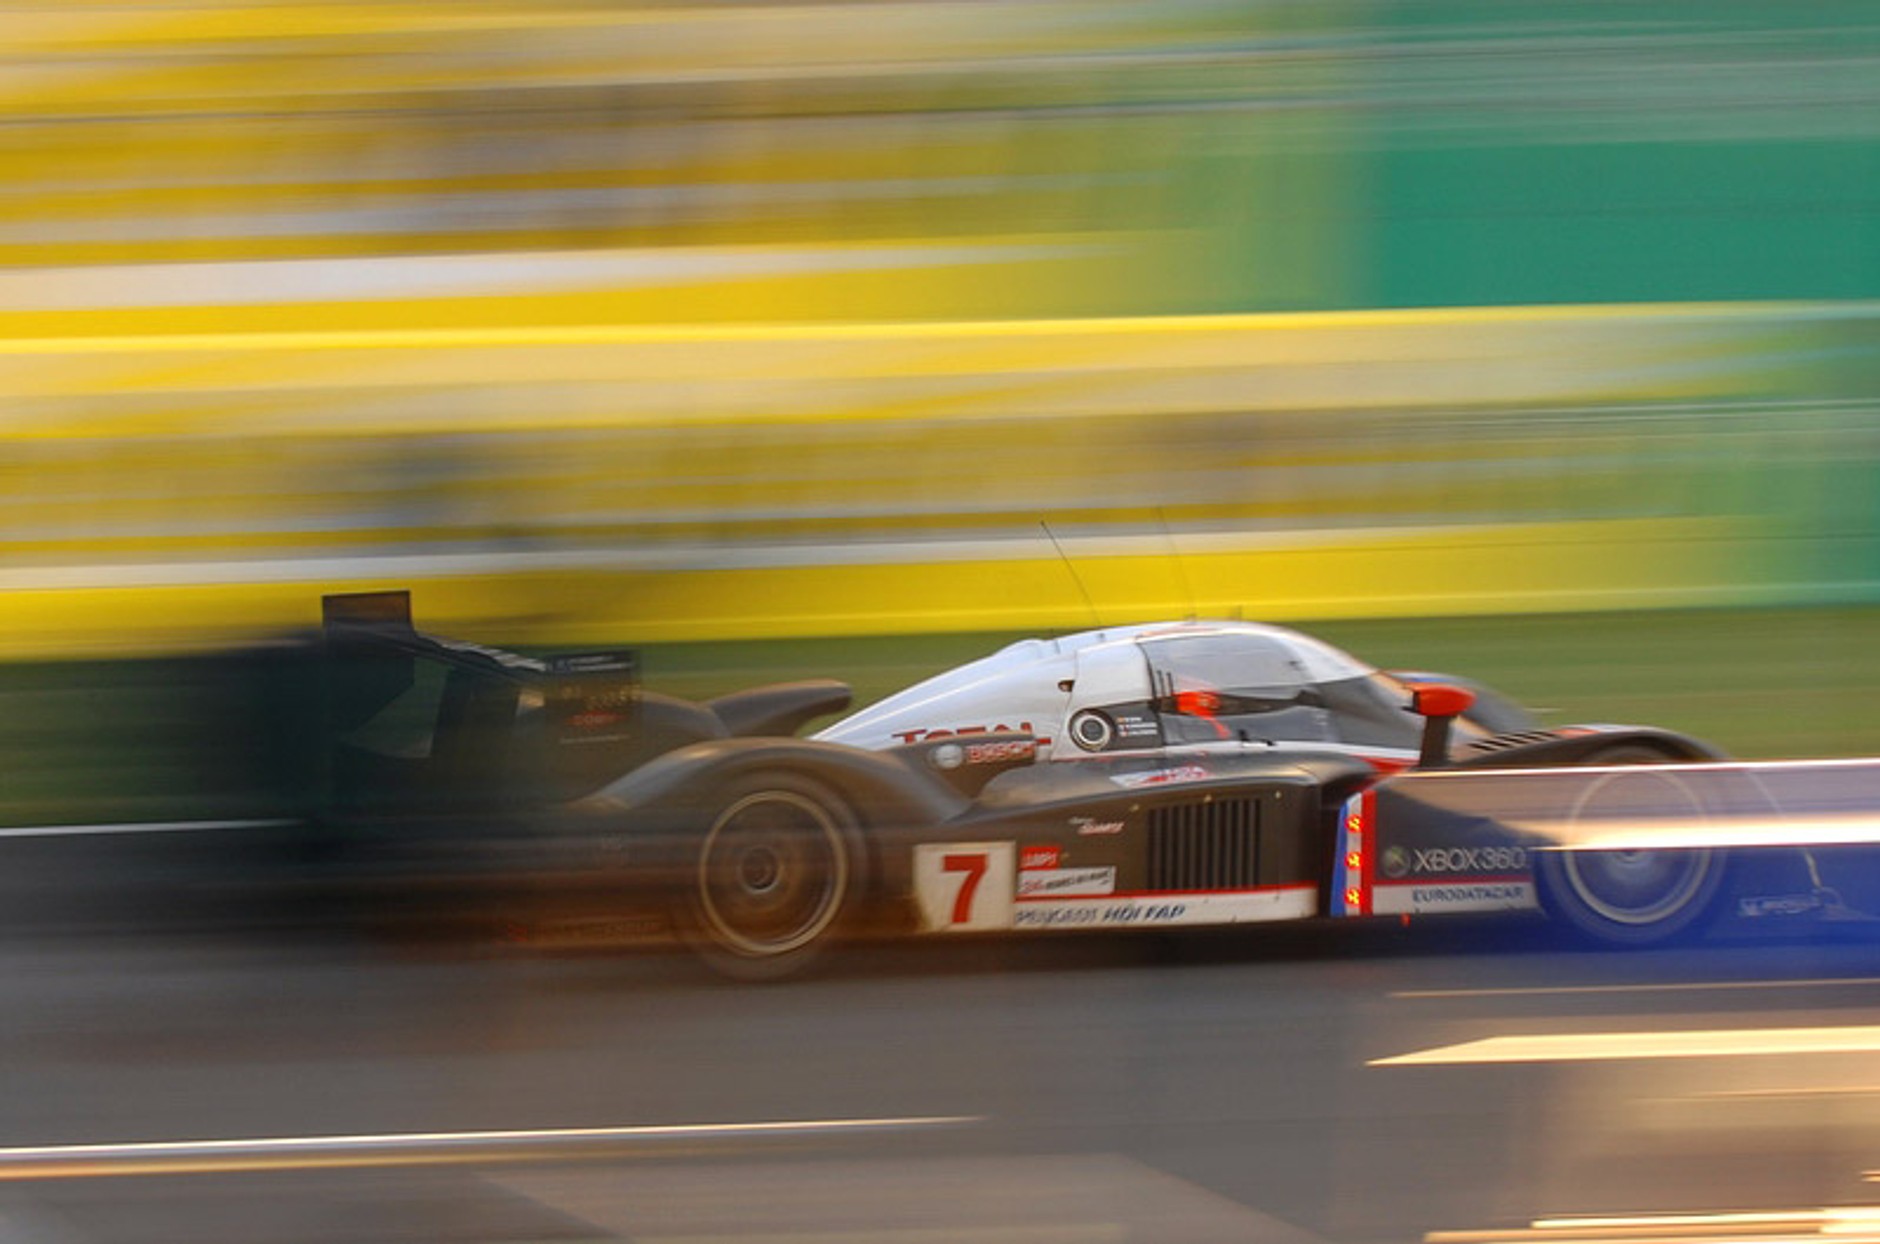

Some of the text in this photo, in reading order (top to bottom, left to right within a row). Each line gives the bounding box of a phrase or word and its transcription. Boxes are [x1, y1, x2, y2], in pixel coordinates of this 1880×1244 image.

[942, 853, 988, 924] 7
[1412, 886, 1525, 904] EURODATACAR
[1016, 907, 1099, 923] PEUGEOT
[1145, 903, 1187, 919] FAP
